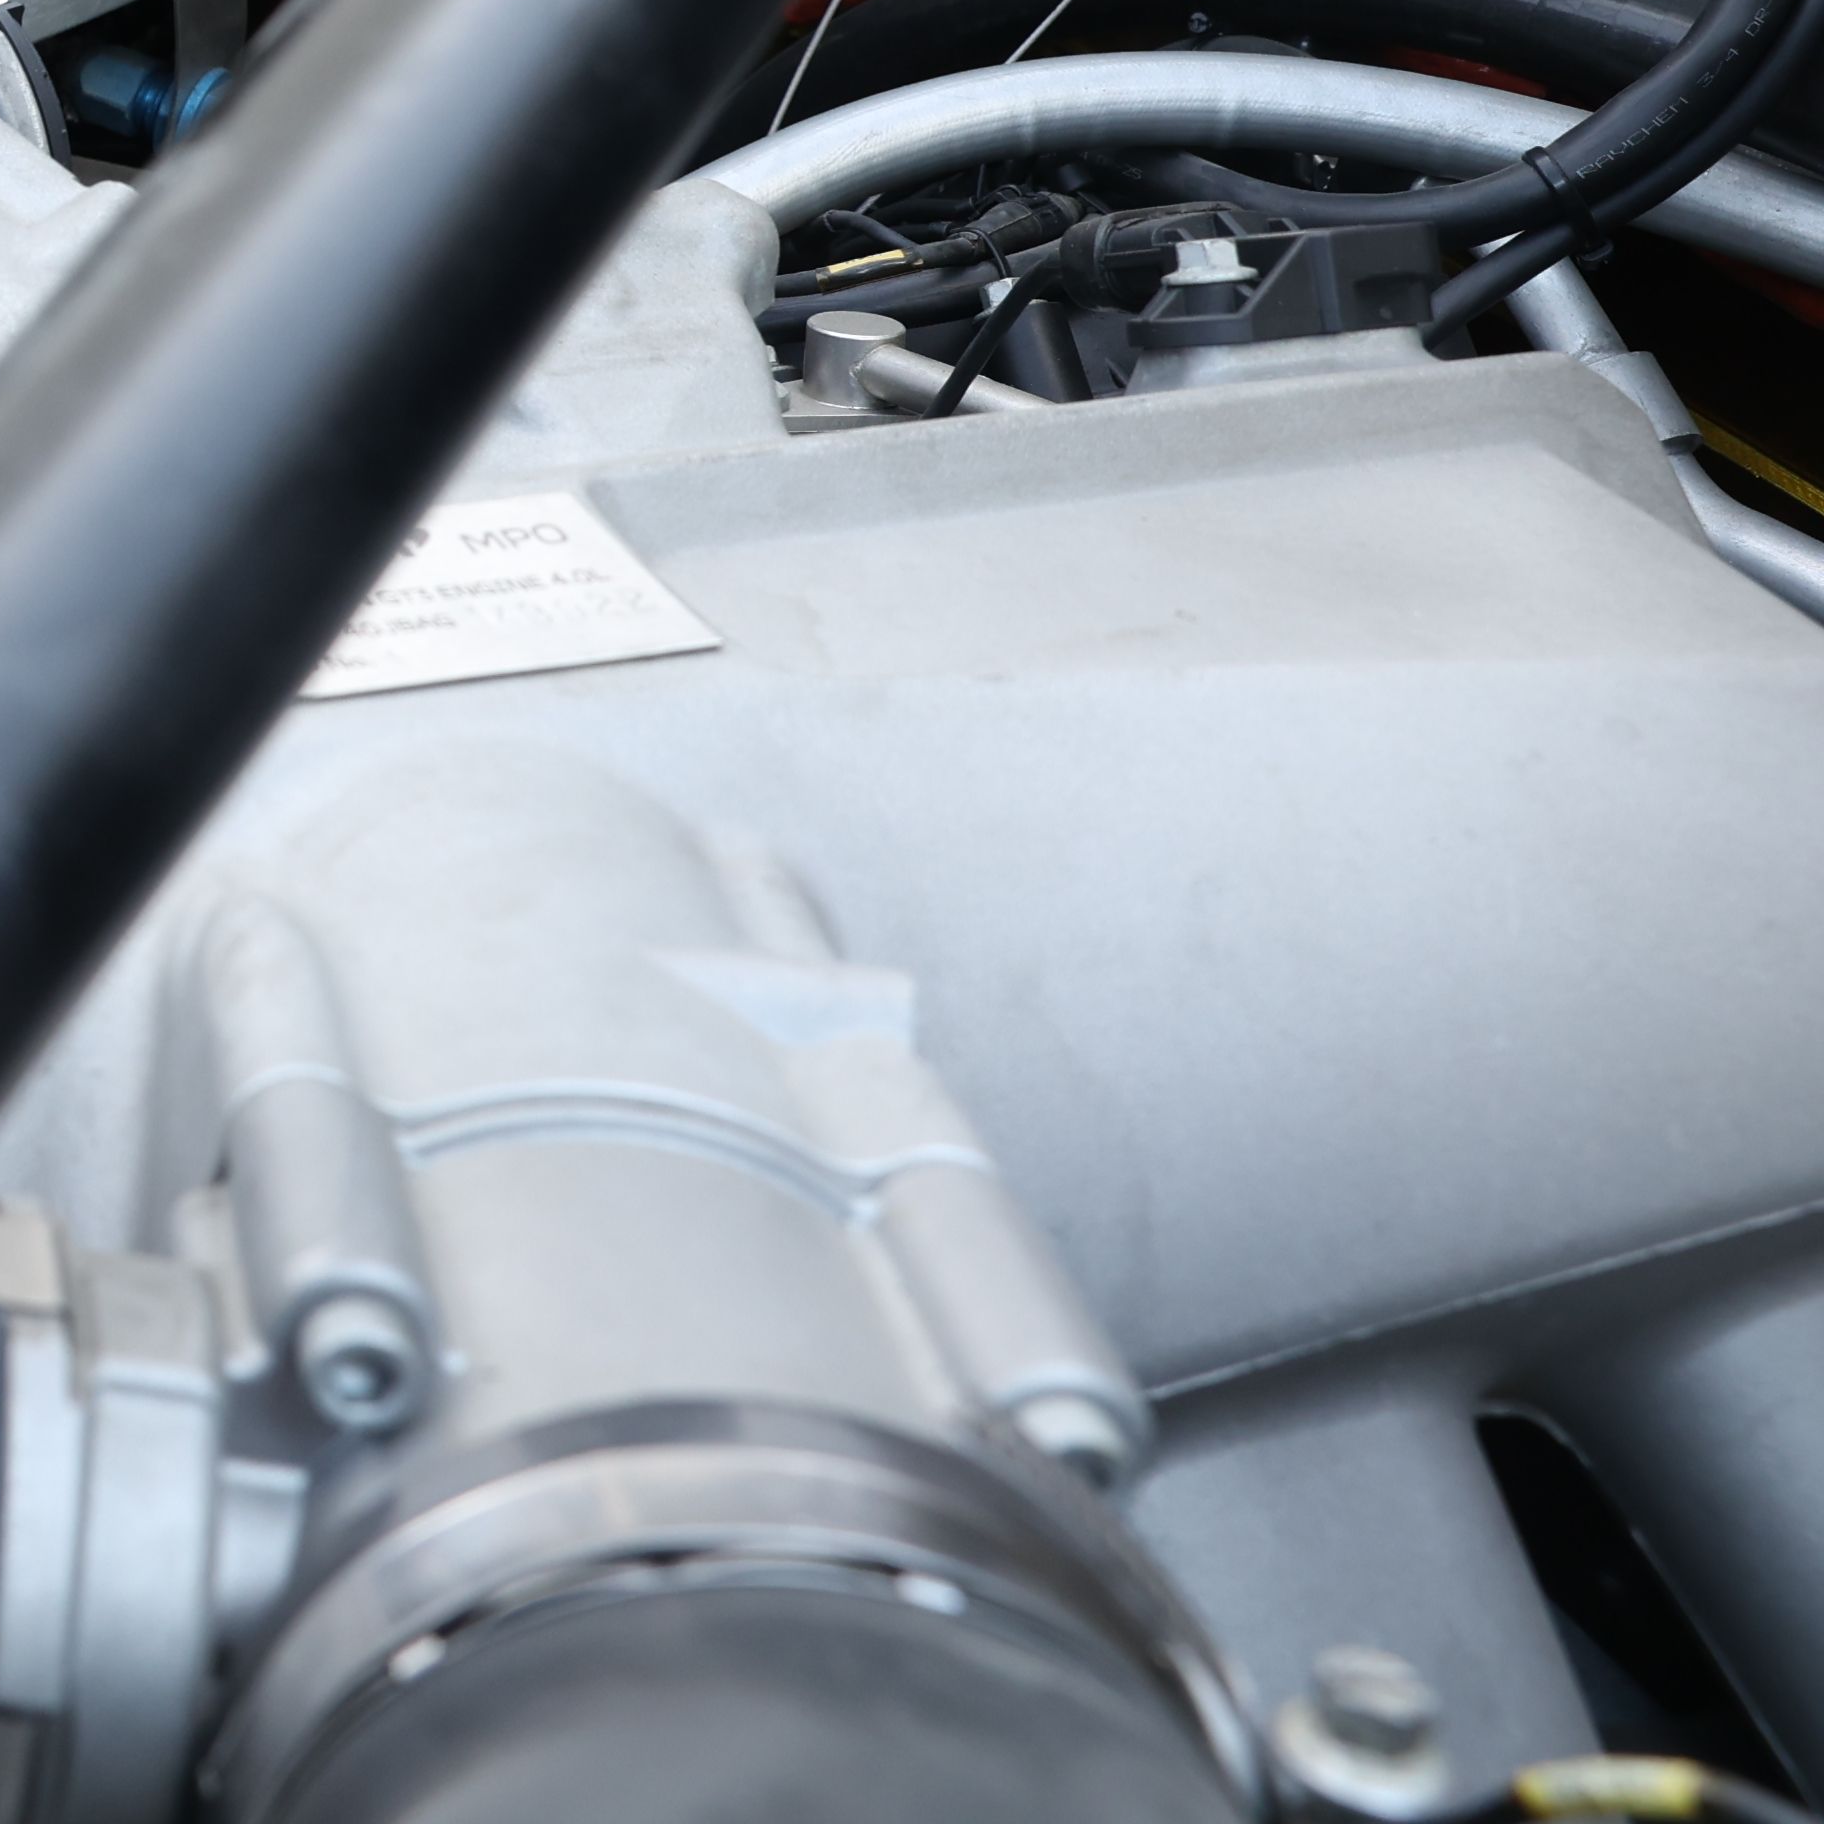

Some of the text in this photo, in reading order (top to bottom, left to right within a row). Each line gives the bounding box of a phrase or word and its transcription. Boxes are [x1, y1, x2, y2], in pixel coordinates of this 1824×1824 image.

[1575, 95, 1689, 179] RAYCHEM
[459, 522, 570, 554] MPO
[435, 575, 546, 598] ENGINE
